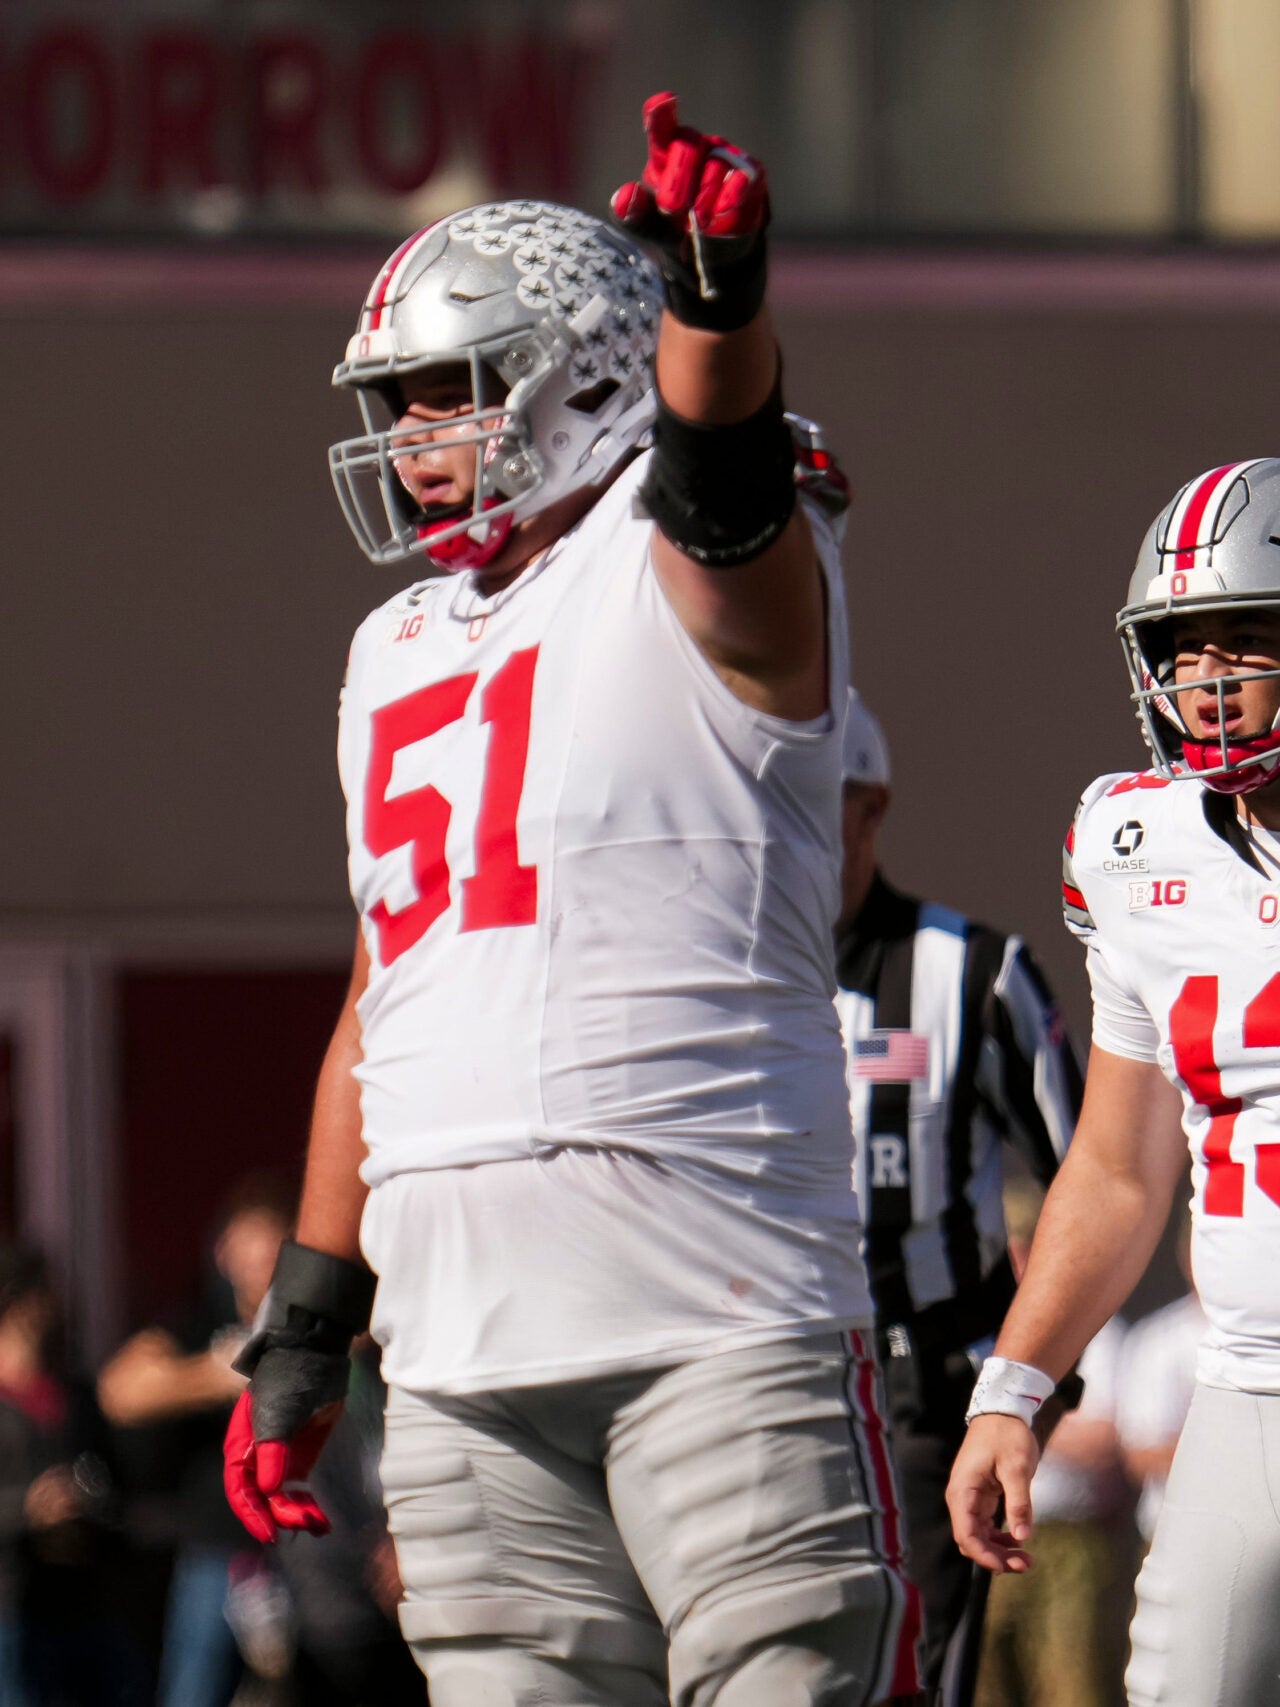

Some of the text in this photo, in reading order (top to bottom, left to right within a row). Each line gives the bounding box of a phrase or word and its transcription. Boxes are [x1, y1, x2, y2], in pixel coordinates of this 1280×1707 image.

[0, 28, 598, 200] ORROW
[362, 640, 541, 969] 51
[1103, 859, 1146, 872] CHASE
[870, 1133, 906, 1188] R
